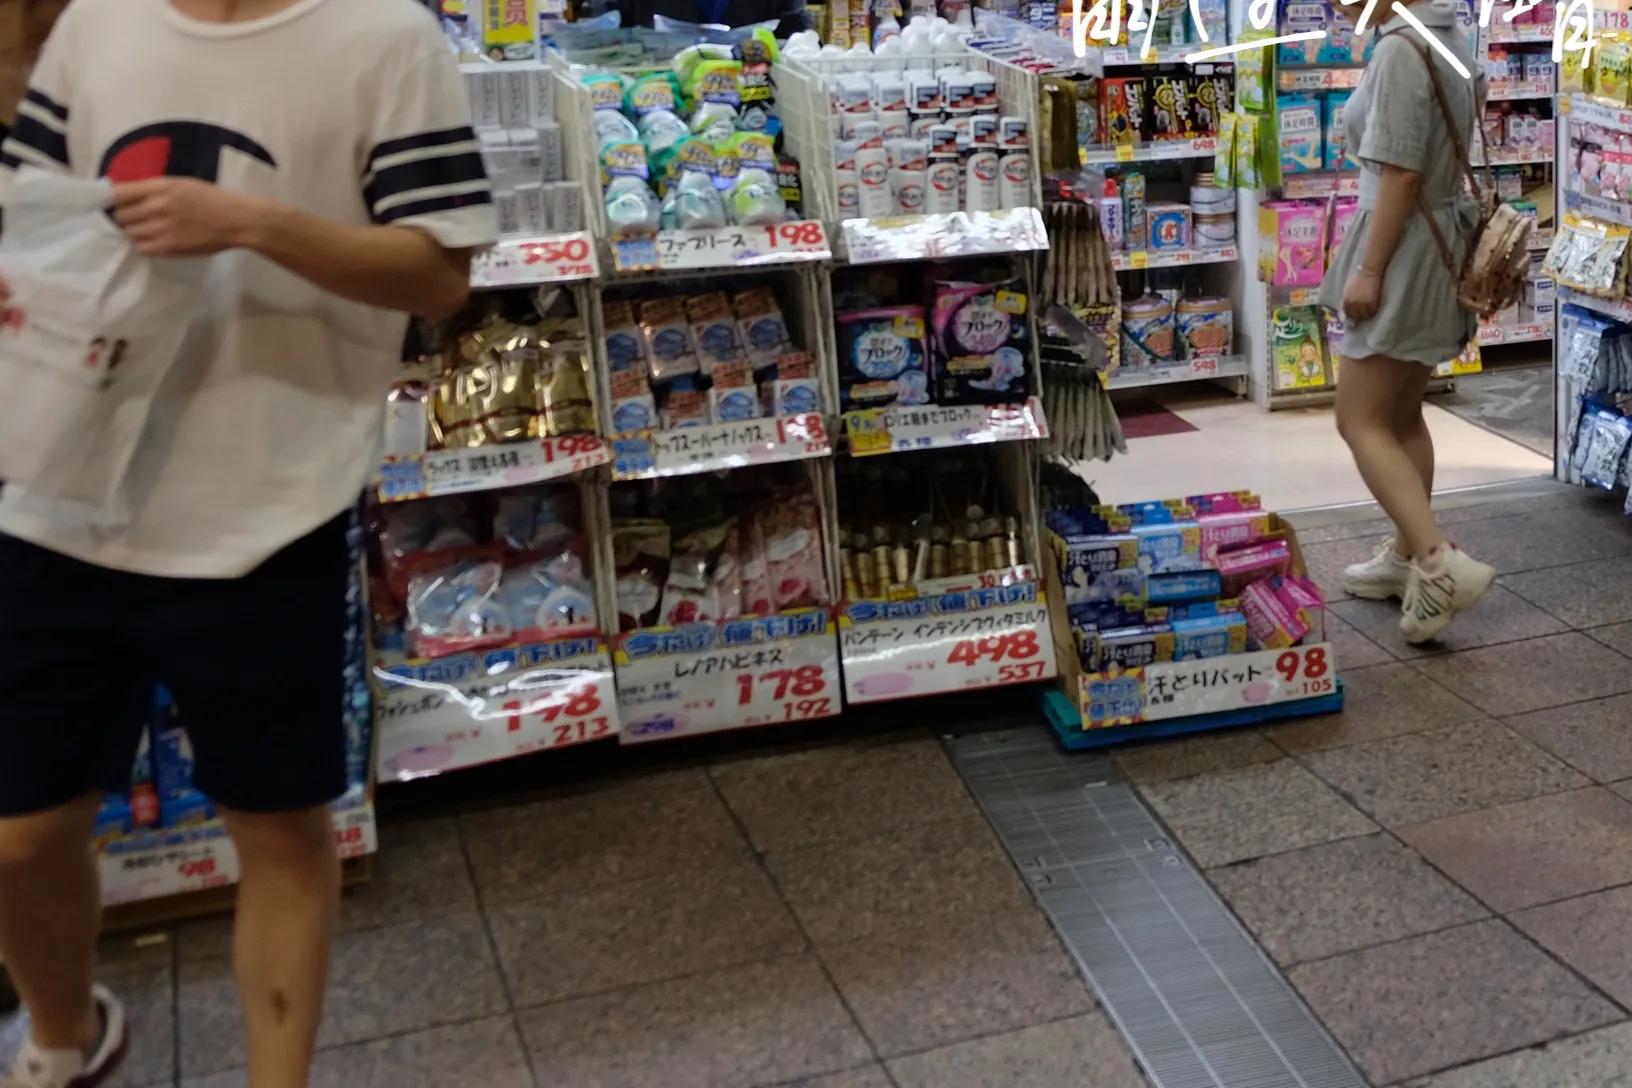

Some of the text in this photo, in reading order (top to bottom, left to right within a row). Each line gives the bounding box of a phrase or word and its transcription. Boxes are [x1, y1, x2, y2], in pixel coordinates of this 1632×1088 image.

[764, 222, 823, 248] 198
[1193, 359, 1217, 372] 598
[947, 630, 1040, 666] 498
[997, 661, 1046, 681] 537
[1275, 647, 1328, 683] 98
[736, 665, 824, 703] 178
[1302, 679, 1332, 694] 105
[783, 698, 830, 718] 192
[553, 717, 608, 744] 213
